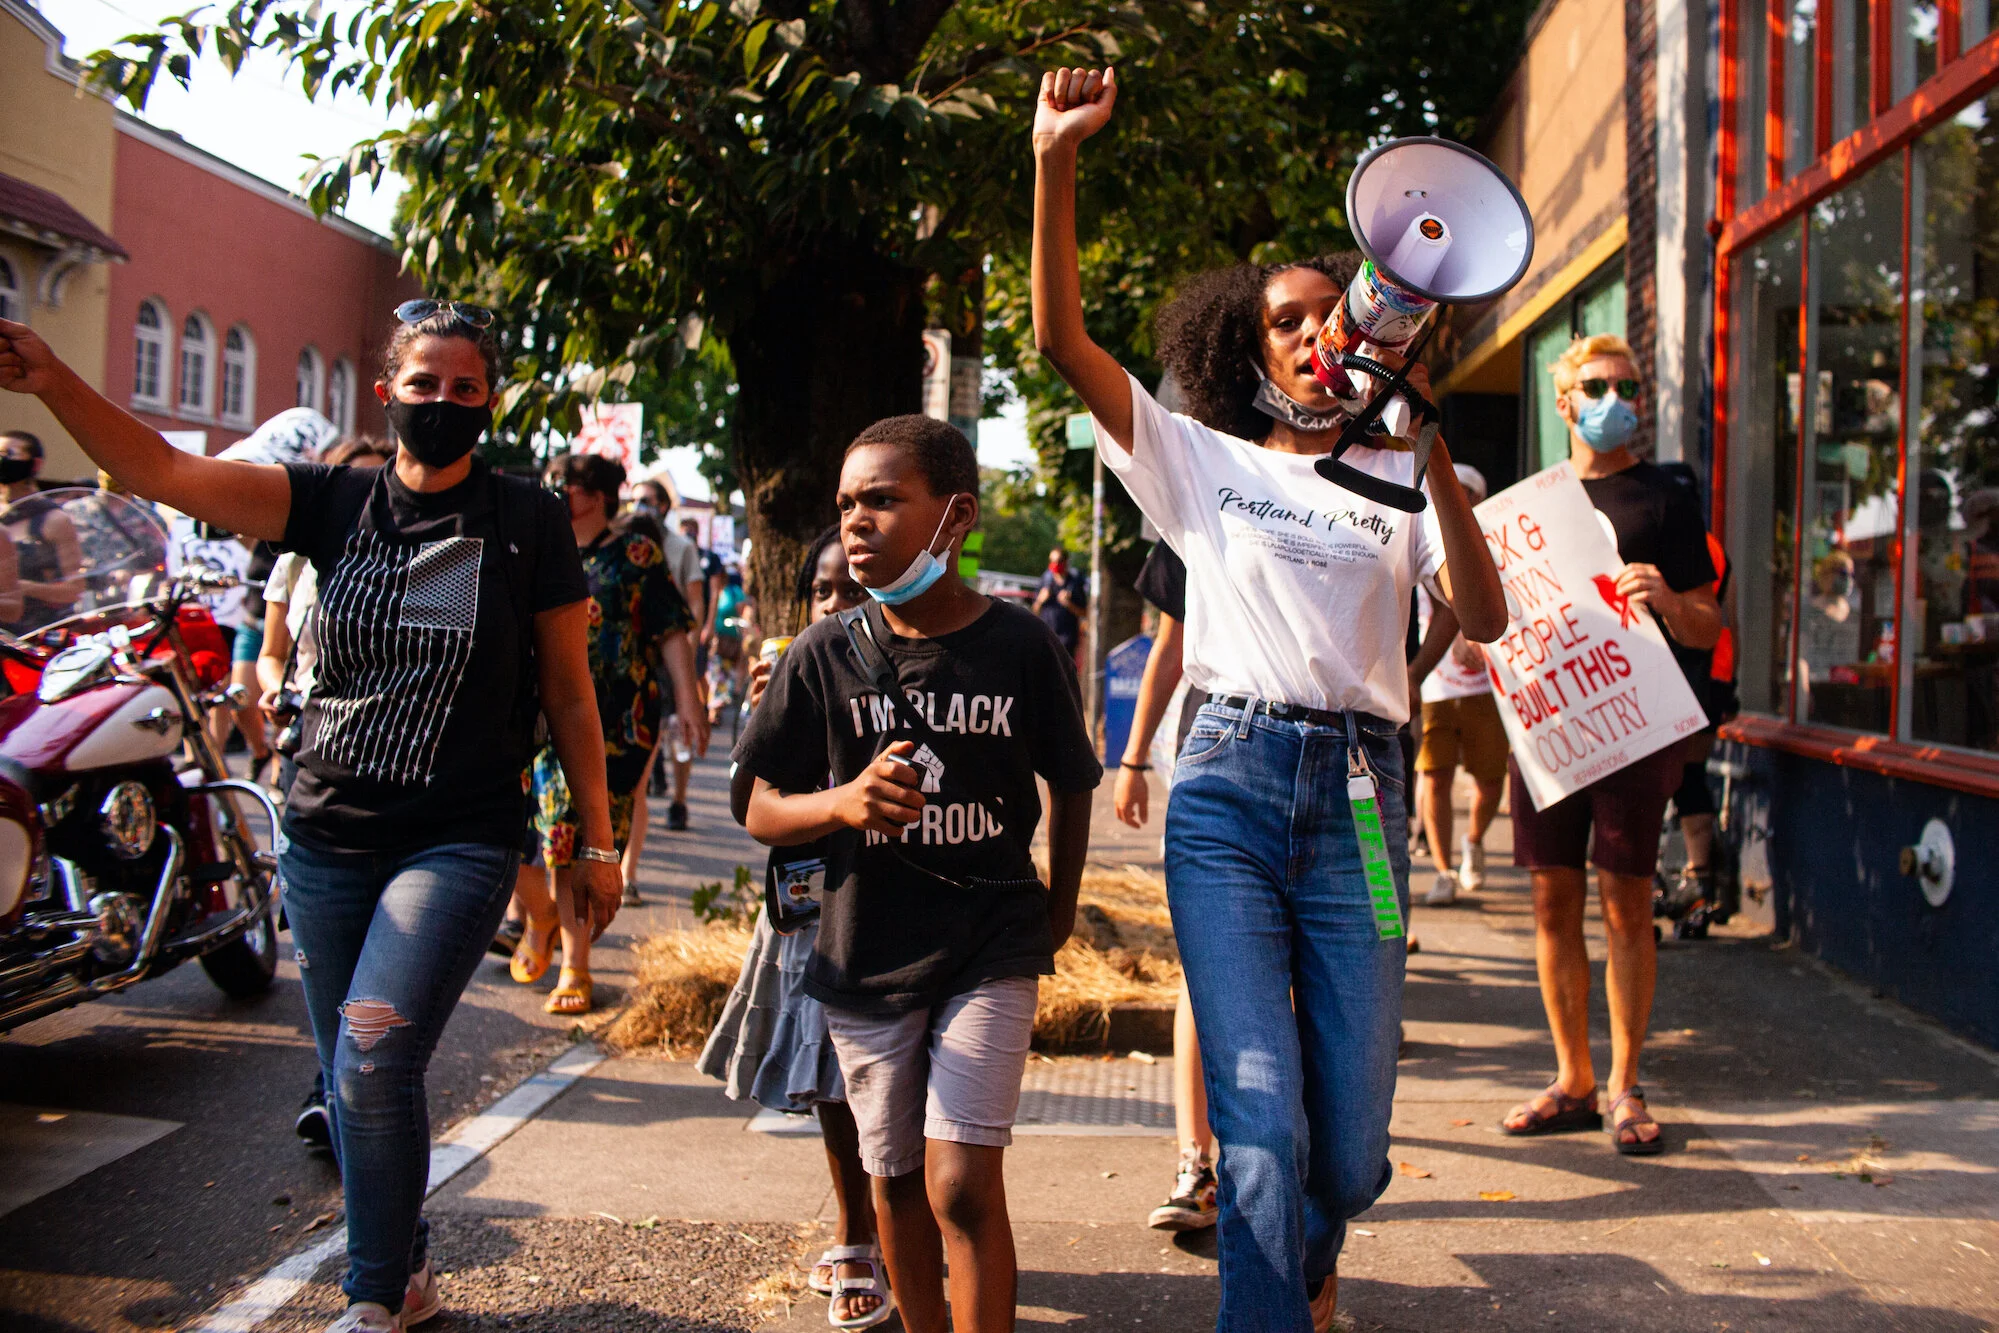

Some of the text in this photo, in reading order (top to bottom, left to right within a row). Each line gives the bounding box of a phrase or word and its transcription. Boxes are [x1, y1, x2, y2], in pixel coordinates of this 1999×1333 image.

[1219, 487, 1396, 545] Portland Pretty
[1517, 512, 1547, 552] &
[1274, 552, 1305, 565] PORTLAND
[1500, 603, 1590, 680] PEOPLE
[1510, 639, 1632, 731] BUILT THIS
[850, 693, 897, 738] I'M
[1536, 686, 1649, 775] COUNTRY
